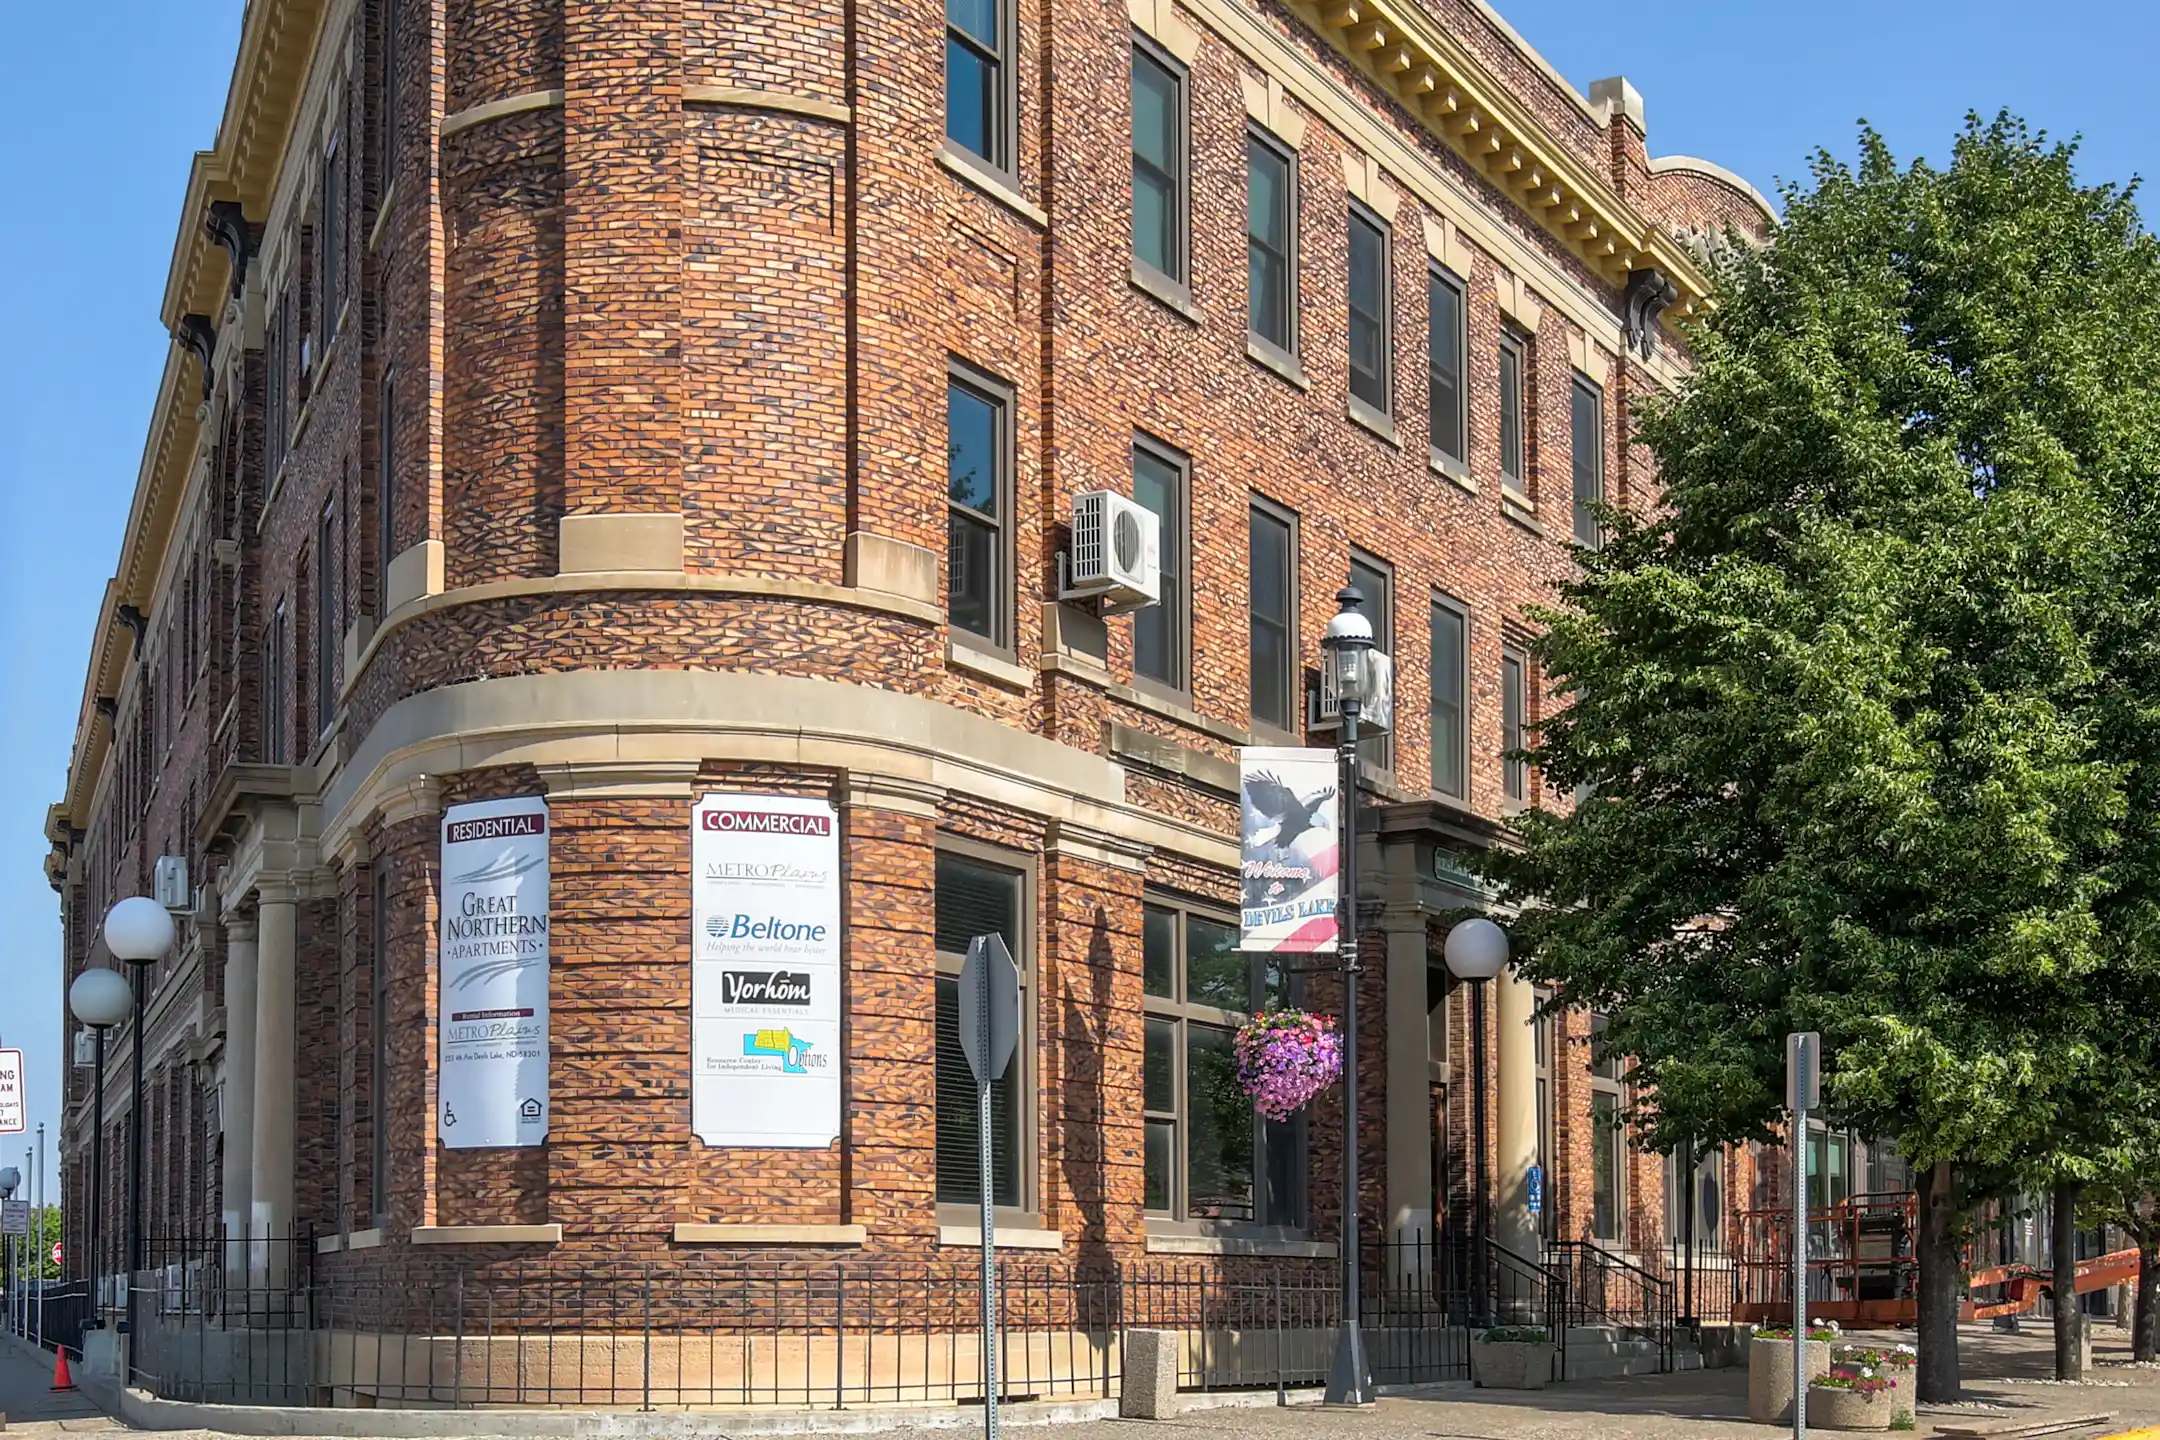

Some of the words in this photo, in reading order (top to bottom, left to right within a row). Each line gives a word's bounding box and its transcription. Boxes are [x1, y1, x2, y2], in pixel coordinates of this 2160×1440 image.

[453, 817, 536, 841] RESIDENTIAL
[706, 812, 828, 835] COMMERCIAL
[1244, 860, 1310, 879] Welcome
[1268, 881, 1285, 895] to
[1243, 904, 1295, 927] DEVILS
[1298, 898, 1336, 918] LAKE
[447, 914, 548, 941] NORTHERN
[730, 914, 826, 942] Beltone
[451, 939, 537, 959] APARTMENTS
[706, 941, 740, 954] Helping
[742, 942, 755, 952] the
[757, 943, 781, 953] world
[481, 1010, 520, 1019] Information
[763, 1007, 809, 1015] ESSENTIALS
[506, 1050, 517, 1058] ND
[788, 1045, 828, 1070] Options
